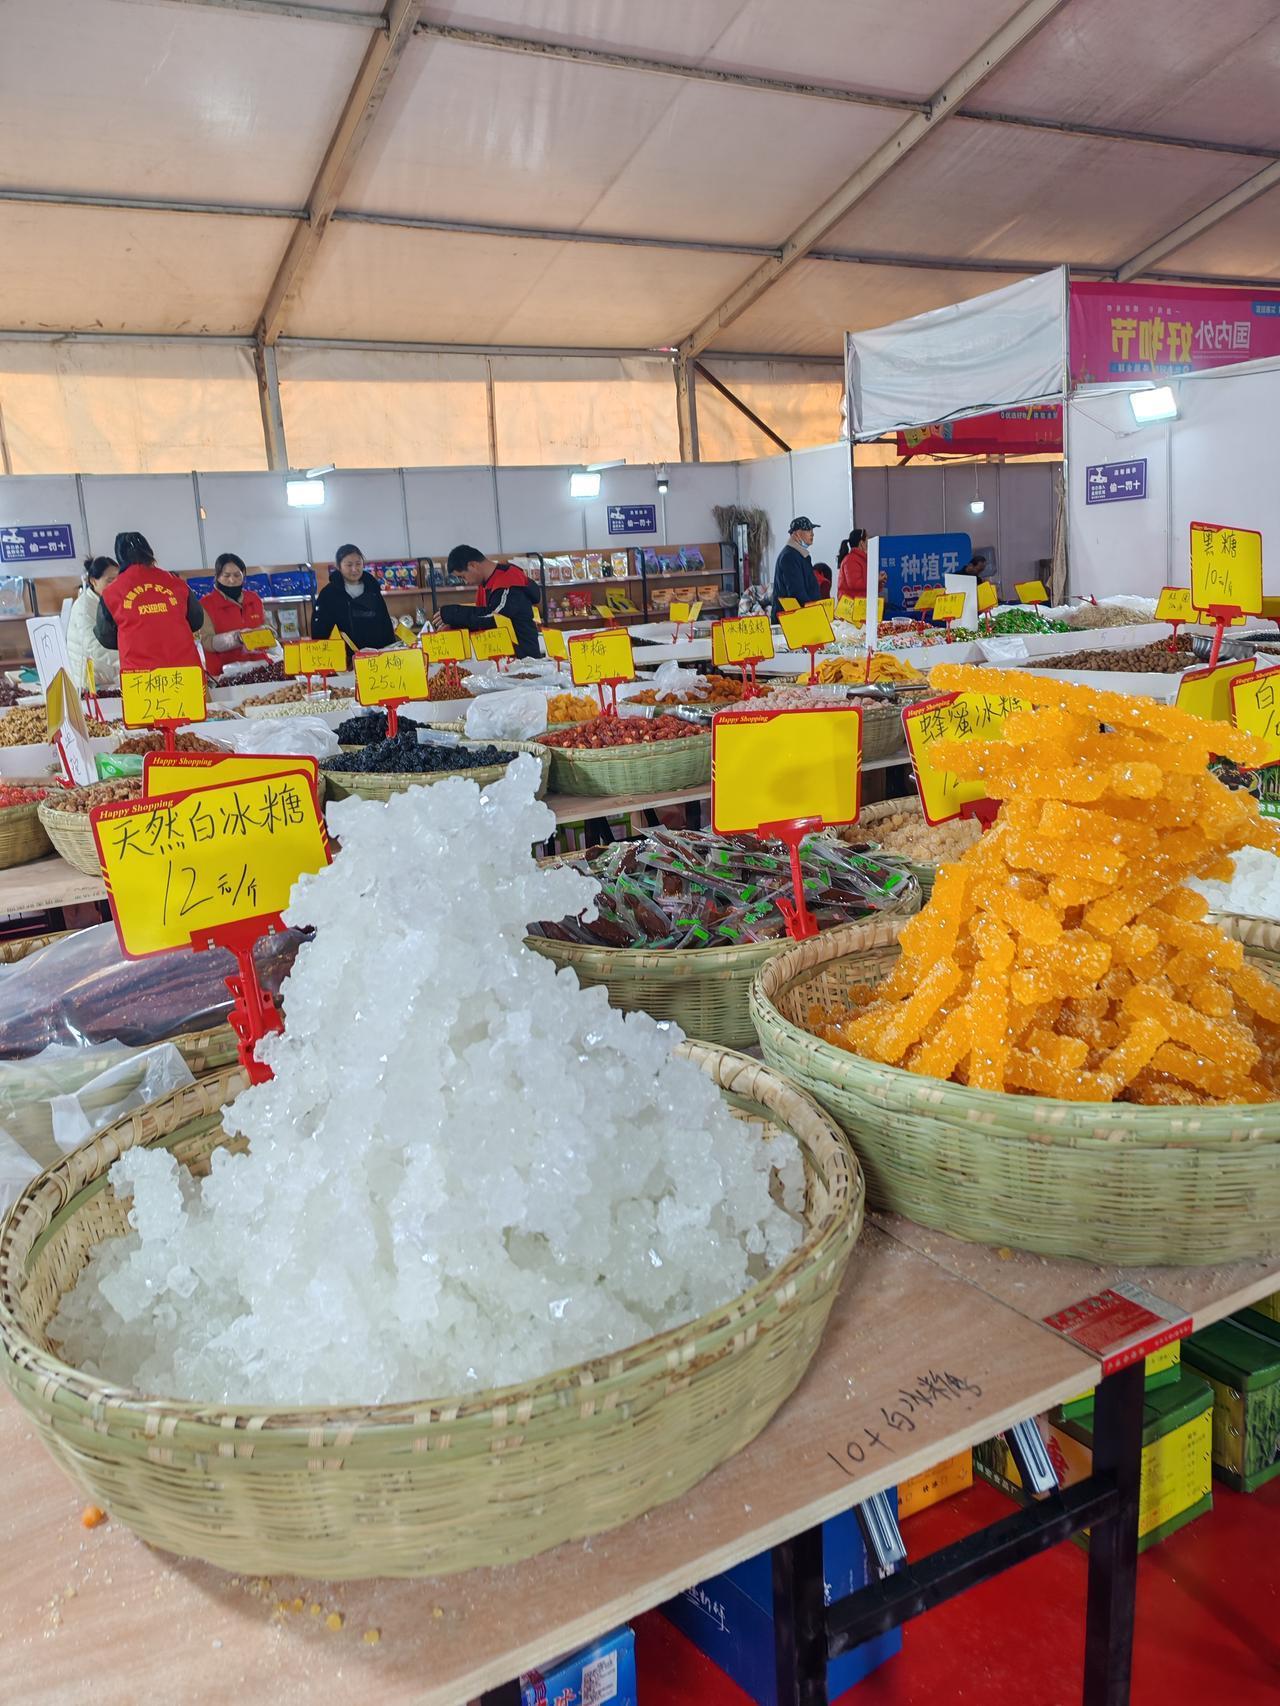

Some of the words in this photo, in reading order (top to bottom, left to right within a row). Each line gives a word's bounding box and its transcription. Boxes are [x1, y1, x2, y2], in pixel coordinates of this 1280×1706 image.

[1202, 529, 1238, 558] 黑糖
[900, 551, 960, 583] 种植牙
[718, 716, 739, 724] Happy
[740, 715, 769, 723] Shopping
[152, 756, 178, 767] Happy
[179, 756, 213, 767] Shopping
[99, 806, 129, 820] Happy
[131, 797, 174, 813] Shopping
[112, 783, 305, 860] 天然白冰糖
